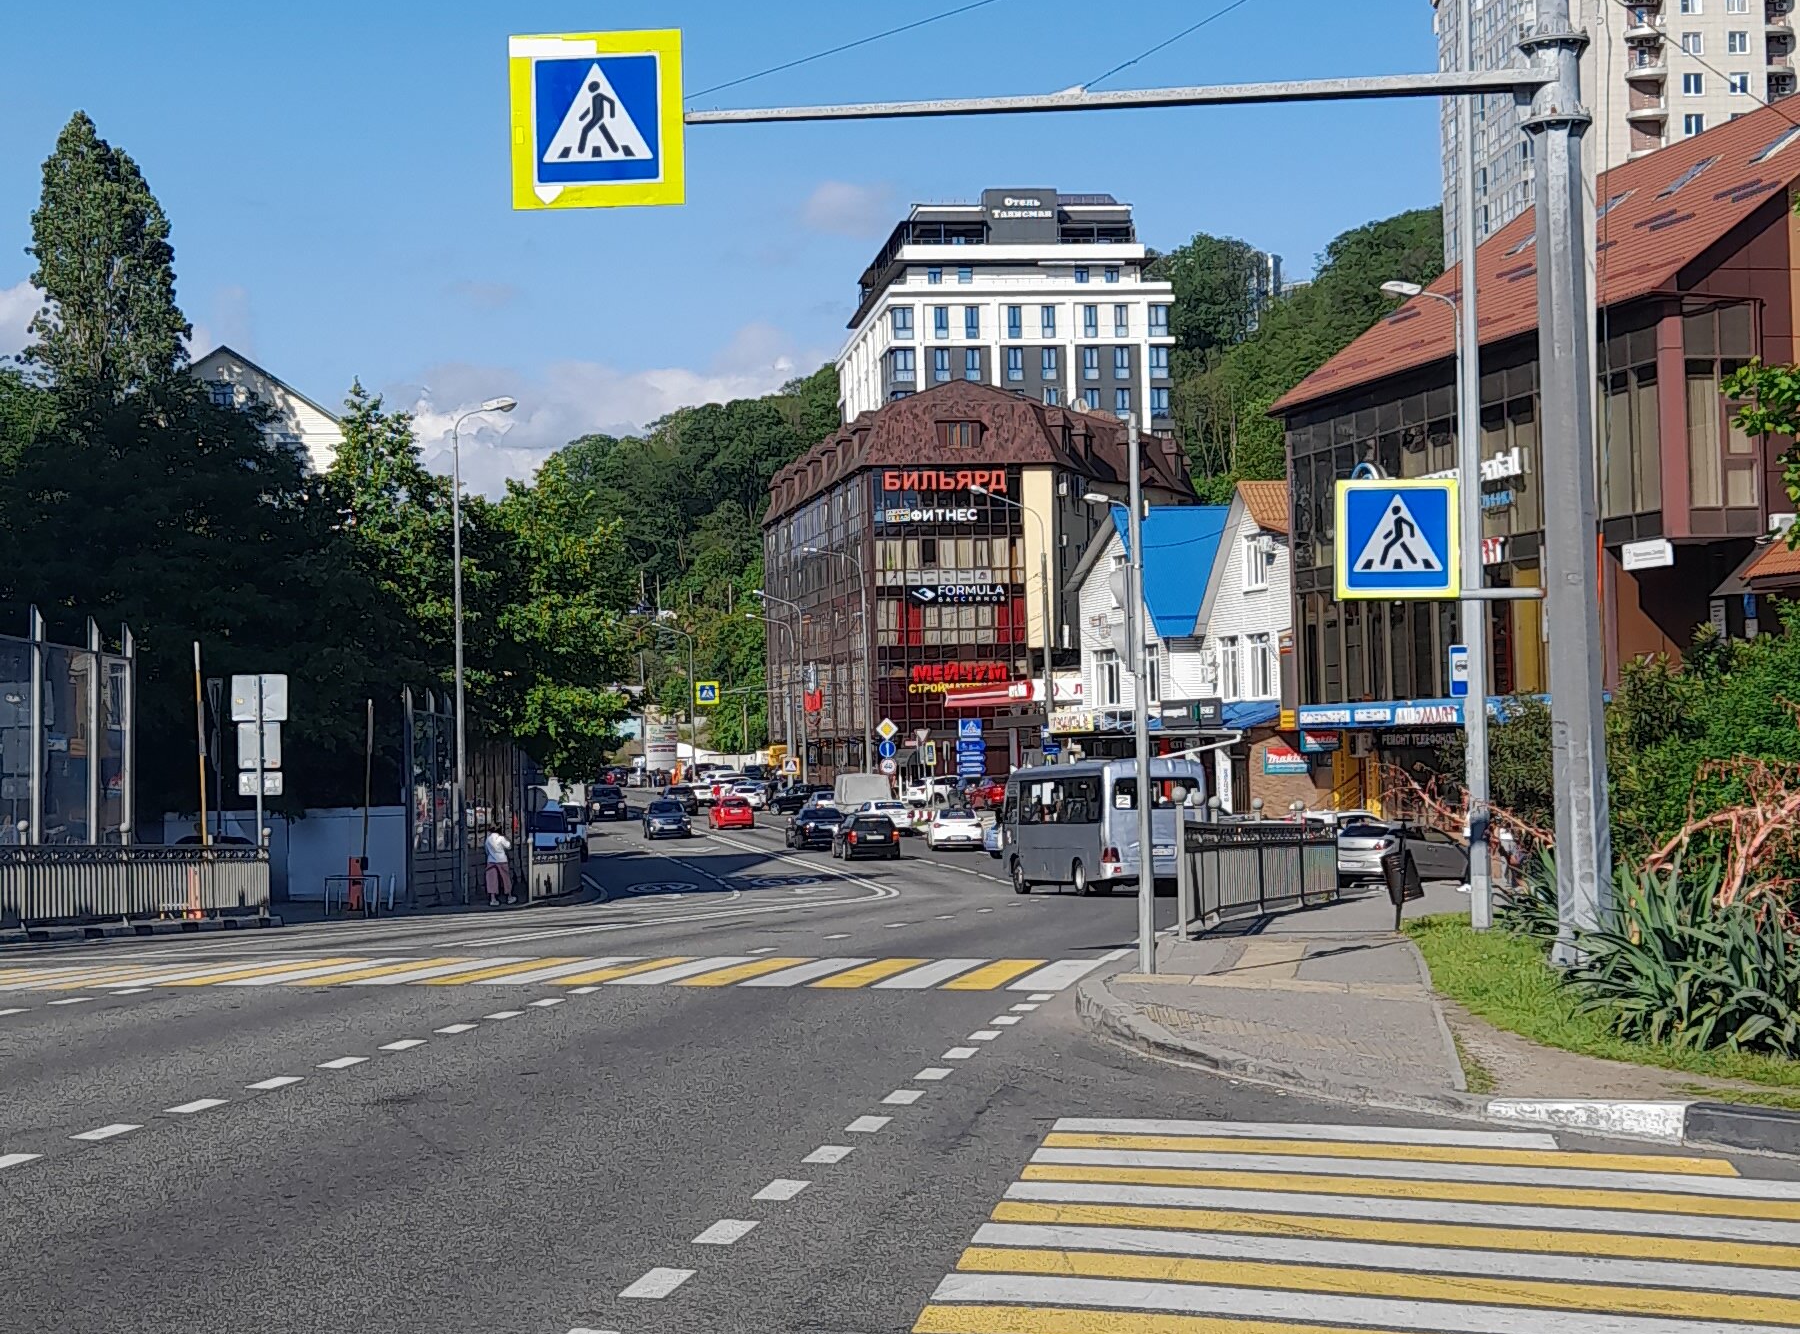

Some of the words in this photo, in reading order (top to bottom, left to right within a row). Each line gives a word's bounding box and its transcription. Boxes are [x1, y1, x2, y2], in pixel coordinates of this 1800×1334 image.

[1004, 197, 1041, 207] Отель
[992, 209, 1053, 219] Талисман
[884, 470, 1007, 493] БИЛЬЯРД
[911, 509, 978, 521] ФИТНЕС
[937, 585, 1004, 595] FORMULA
[913, 661, 1007, 681] МЕЙЧУМ
